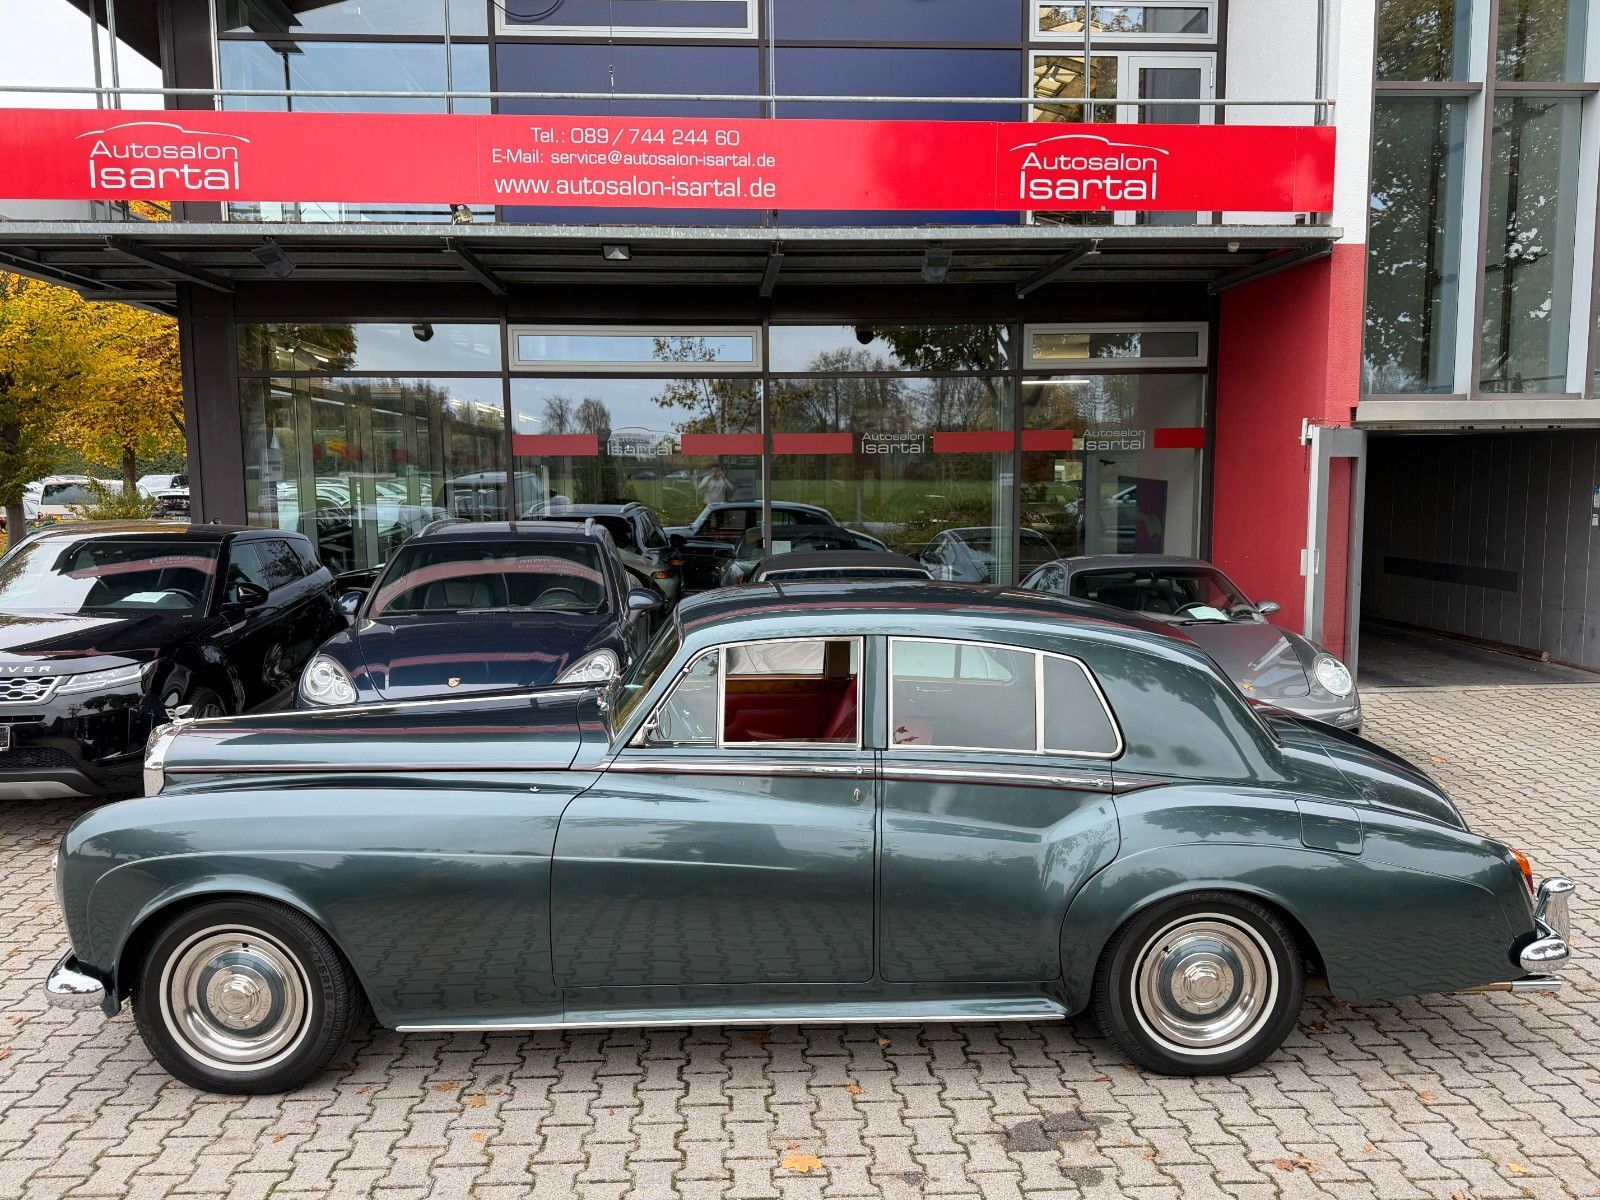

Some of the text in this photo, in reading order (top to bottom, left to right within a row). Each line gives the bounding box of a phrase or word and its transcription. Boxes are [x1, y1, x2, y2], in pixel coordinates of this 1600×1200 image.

[530, 127, 565, 144] Tel.:
[570, 127, 609, 145] 089
[628, 128, 666, 145] 744
[671, 128, 709, 146] 244
[715, 129, 740, 147] 60
[91, 139, 238, 160] Autosalon
[491, 148, 776, 168] E-Mail: service@autosalon-isartal.de
[1021, 151, 1158, 171] Autosalon
[90, 159, 240, 191] Isartal
[1019, 170, 1157, 200] Isartal
[493, 175, 776, 199] www.autosalon-isartal.de
[861, 432, 925, 441] Autosalon
[1082, 429, 1146, 438] Autosalon
[607, 442, 673, 456] Isartal
[861, 440, 925, 454] Isartal
[1080, 437, 1145, 451] Isartal
